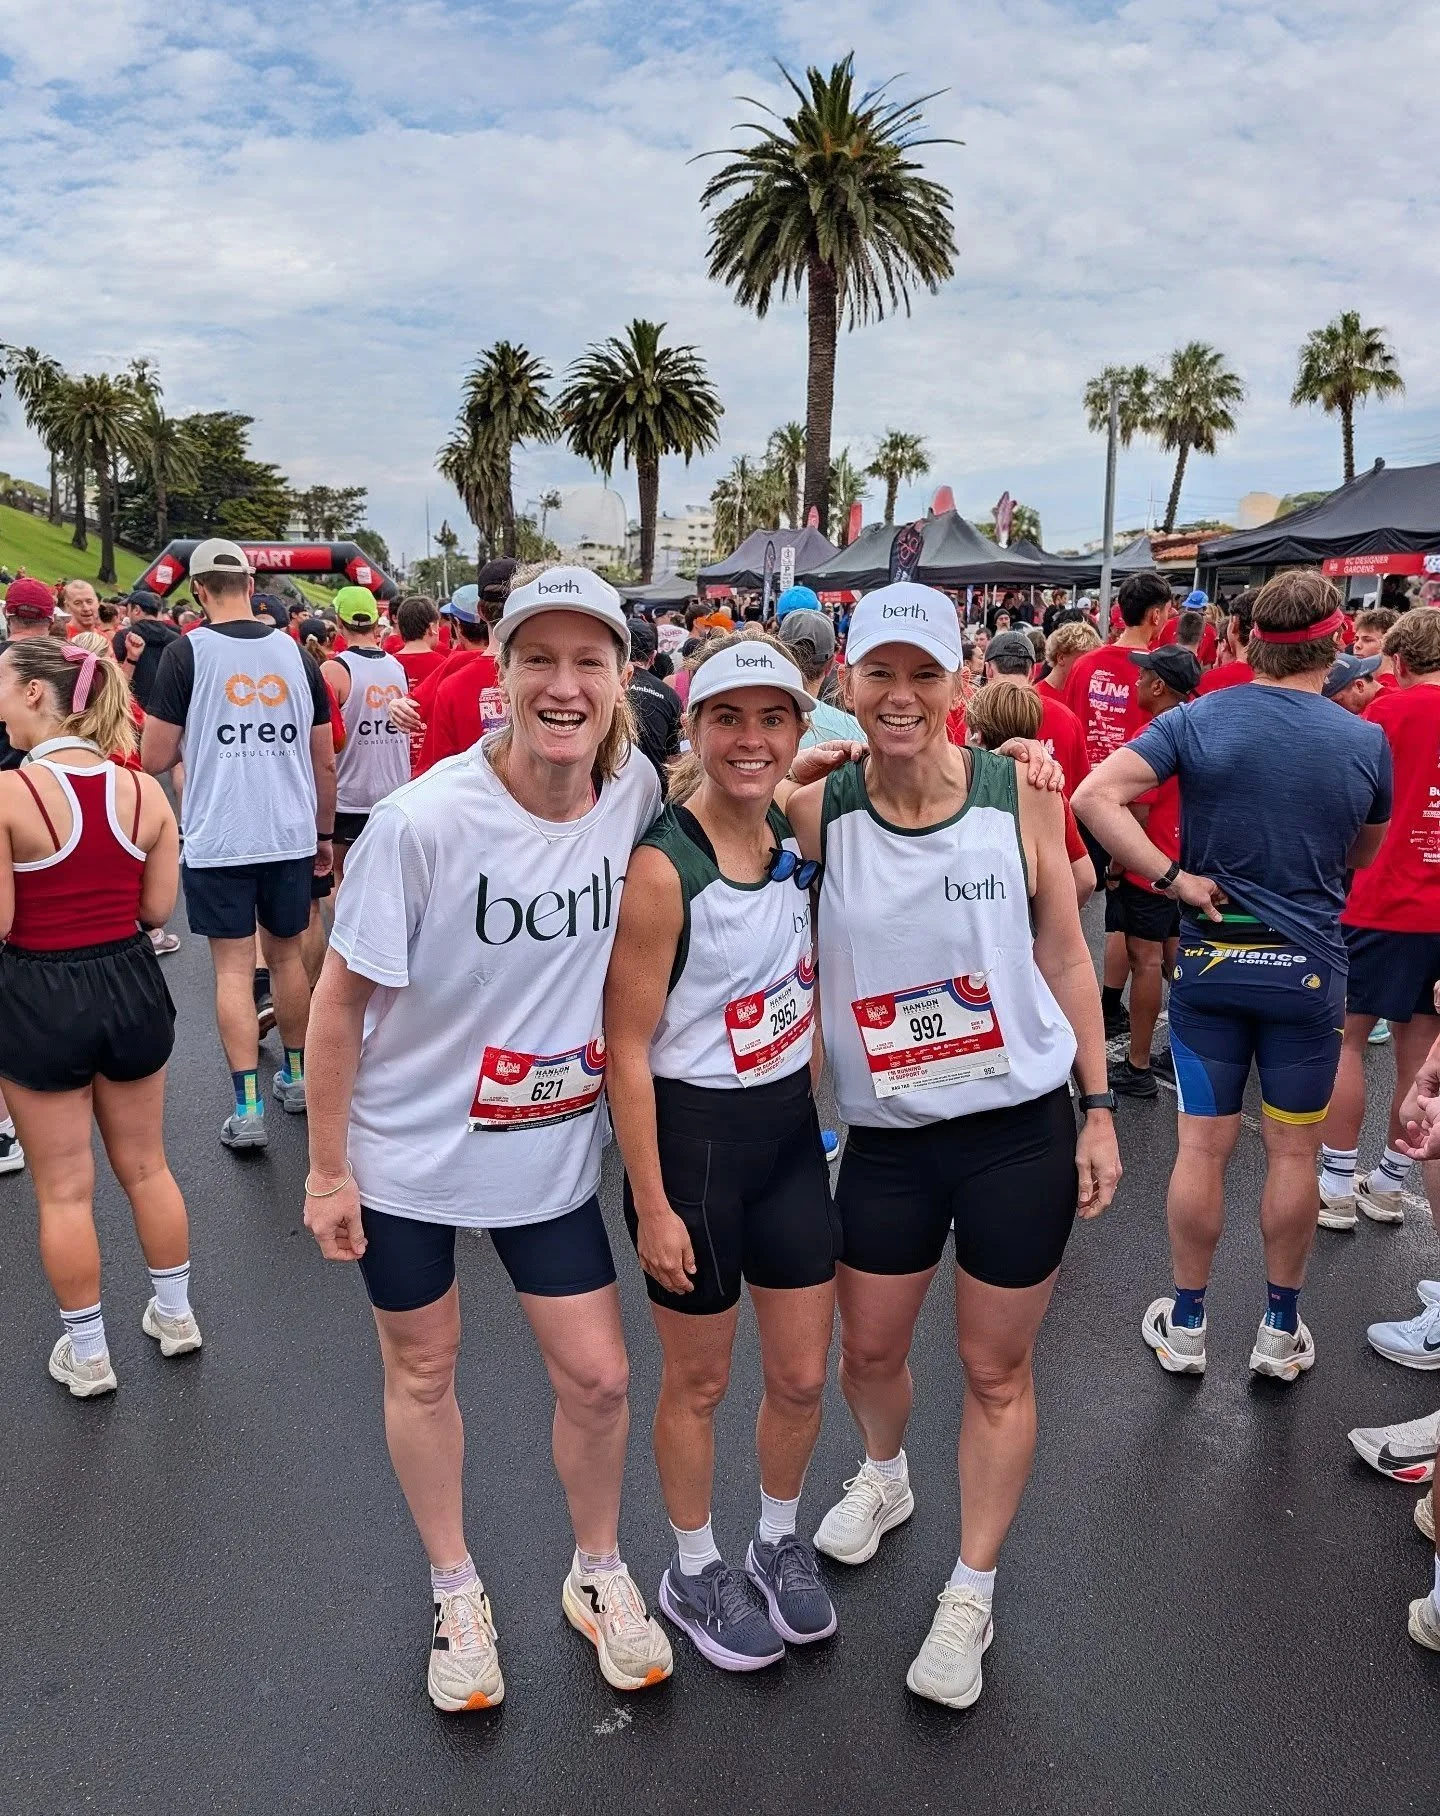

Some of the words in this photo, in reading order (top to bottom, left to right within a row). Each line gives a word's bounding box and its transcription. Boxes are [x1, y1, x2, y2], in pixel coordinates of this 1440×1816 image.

[245, 550, 294, 567] TART
[1355, 555, 1390, 564] DESIGNER
[1343, 565, 1375, 574] GARDENS
[538, 579, 583, 596] berth.
[882, 603, 929, 622] berth.
[735, 653, 776, 671] berth.
[630, 684, 665, 700] Ambition
[1089, 679, 1130, 698] RUN4
[479, 701, 510, 722] RU
[216, 722, 298, 745] creo
[358, 719, 399, 736] cre
[219, 749, 297, 759] CONSULTANTS
[1183, 947, 1308, 963] tri-alliance
[902, 998, 939, 1012] HANLON
[770, 998, 798, 1037] 2952
[909, 1013, 947, 1042] 992
[535, 1066, 570, 1076] HANLON
[894, 1071, 921, 1081] SUPPORT
[897, 1066, 922, 1075] RUNNING
[983, 1067, 996, 1076] 992
[531, 1079, 564, 1101] 621
